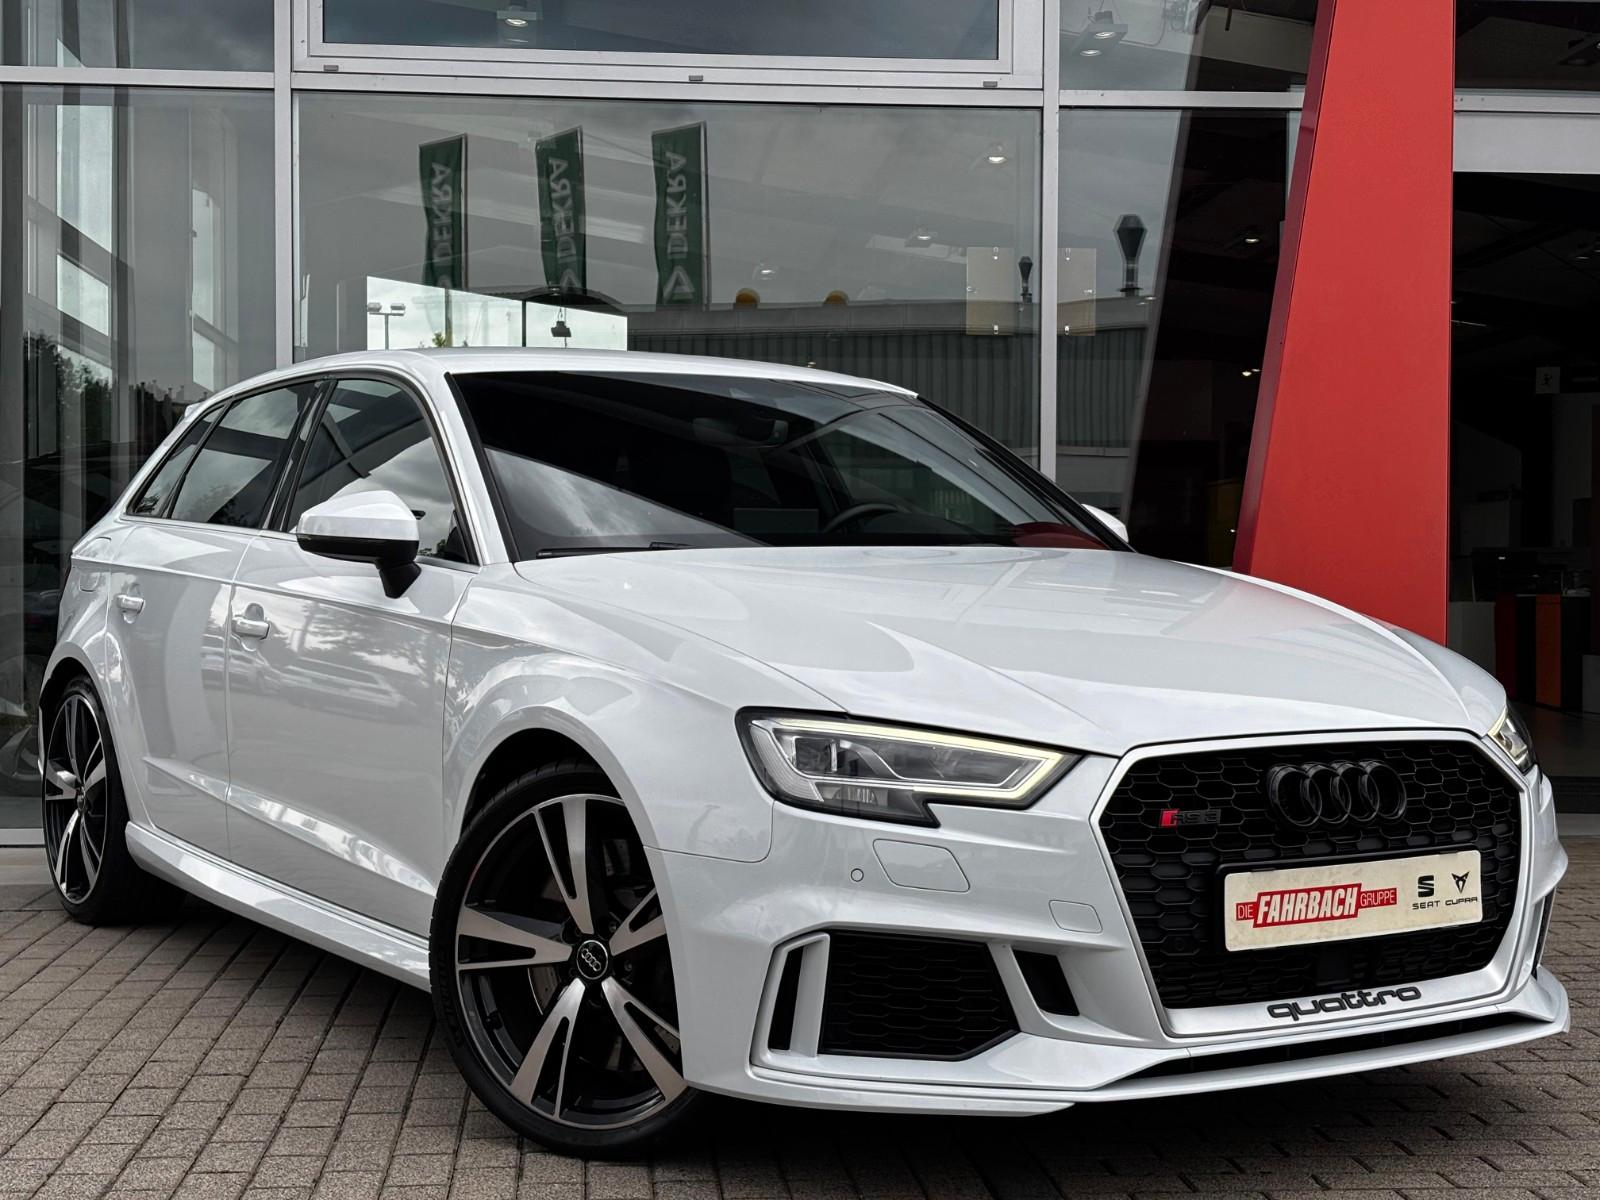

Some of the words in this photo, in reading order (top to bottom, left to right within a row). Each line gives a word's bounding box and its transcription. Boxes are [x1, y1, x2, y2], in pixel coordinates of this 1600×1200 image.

[1237, 904, 1254, 919] DIE
[1256, 887, 1358, 924] FAHRBACH
[1360, 890, 1396, 907] GRUPPE
[1412, 900, 1440, 910] SEAT
[1445, 896, 1478, 906] CUPRA
[1267, 986, 1421, 1021] quattro
